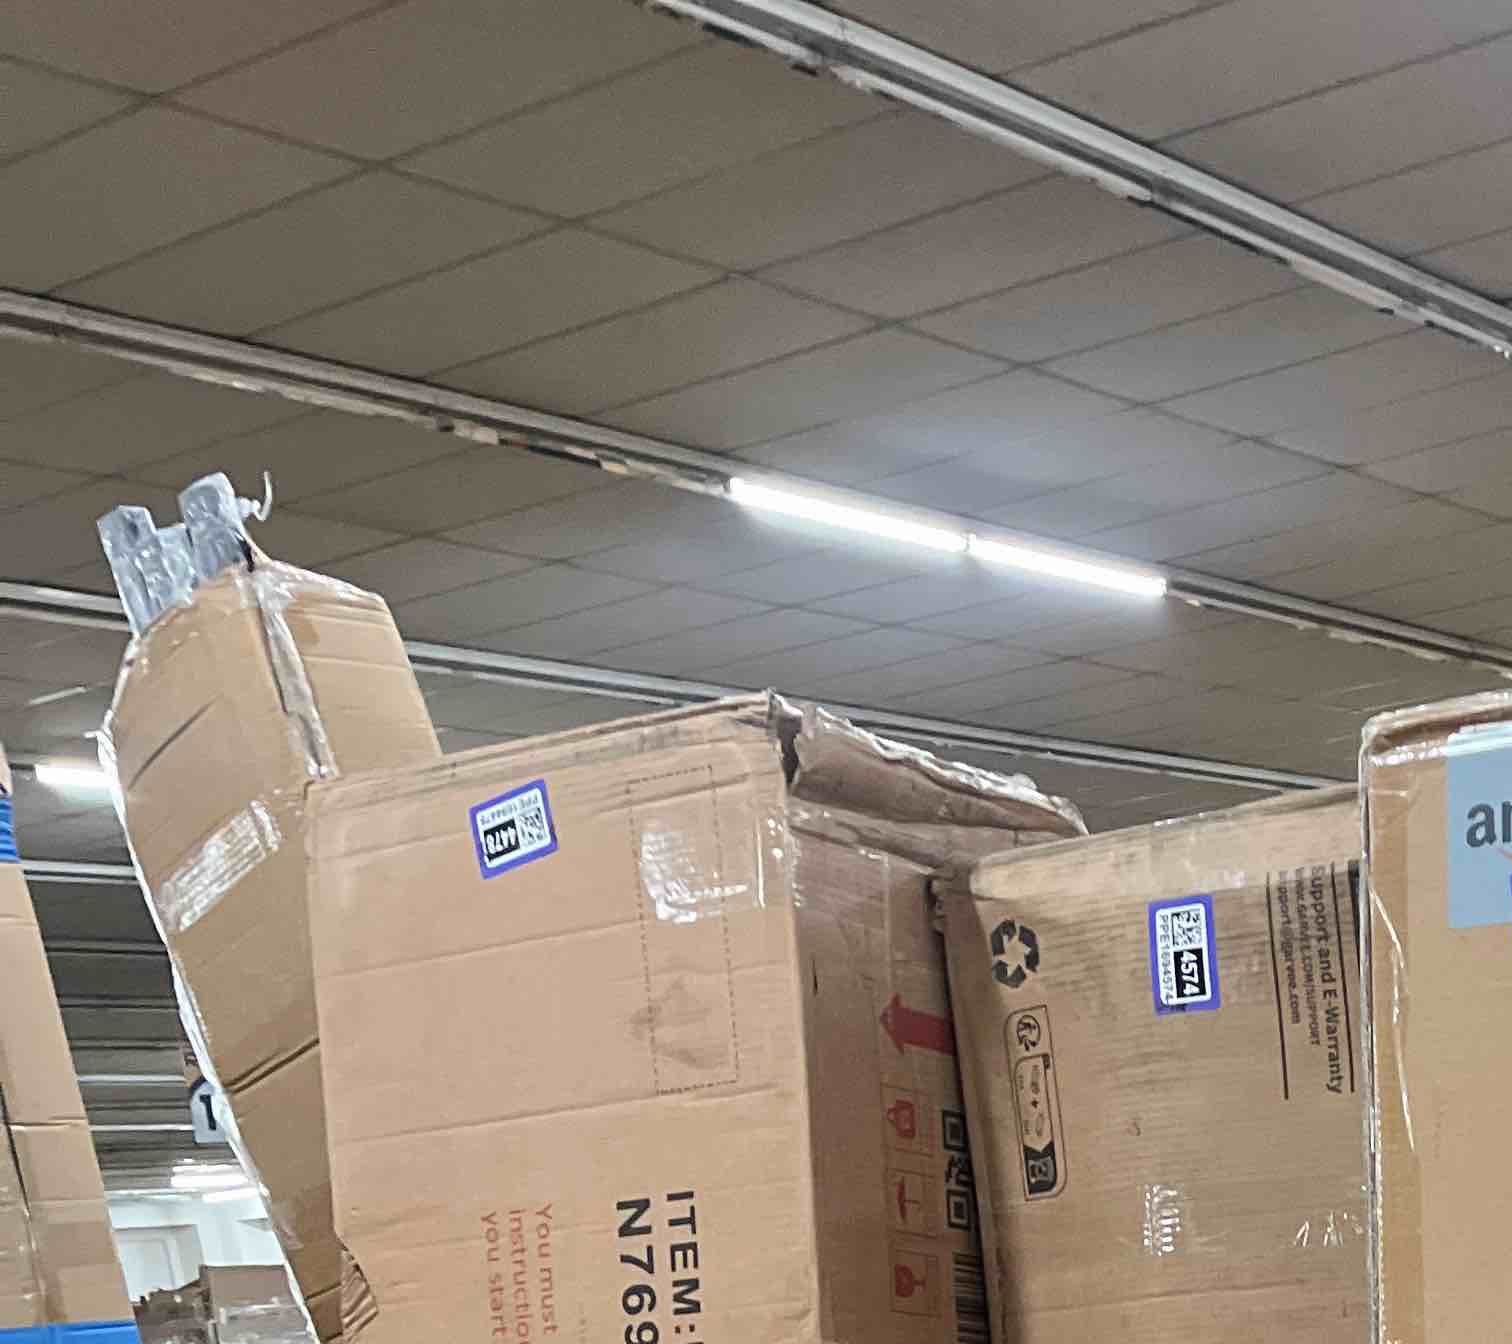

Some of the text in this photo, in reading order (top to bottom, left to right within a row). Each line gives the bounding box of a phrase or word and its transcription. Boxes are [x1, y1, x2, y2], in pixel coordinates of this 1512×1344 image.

[1180, 951, 1199, 995] 4574
[1310, 866, 1343, 1094] Support and E-Warranty
[480, 1211, 500, 1263] you
[535, 1203, 553, 1258] You
[488, 1273, 507, 1337] start
[539, 1267, 559, 1336] must
